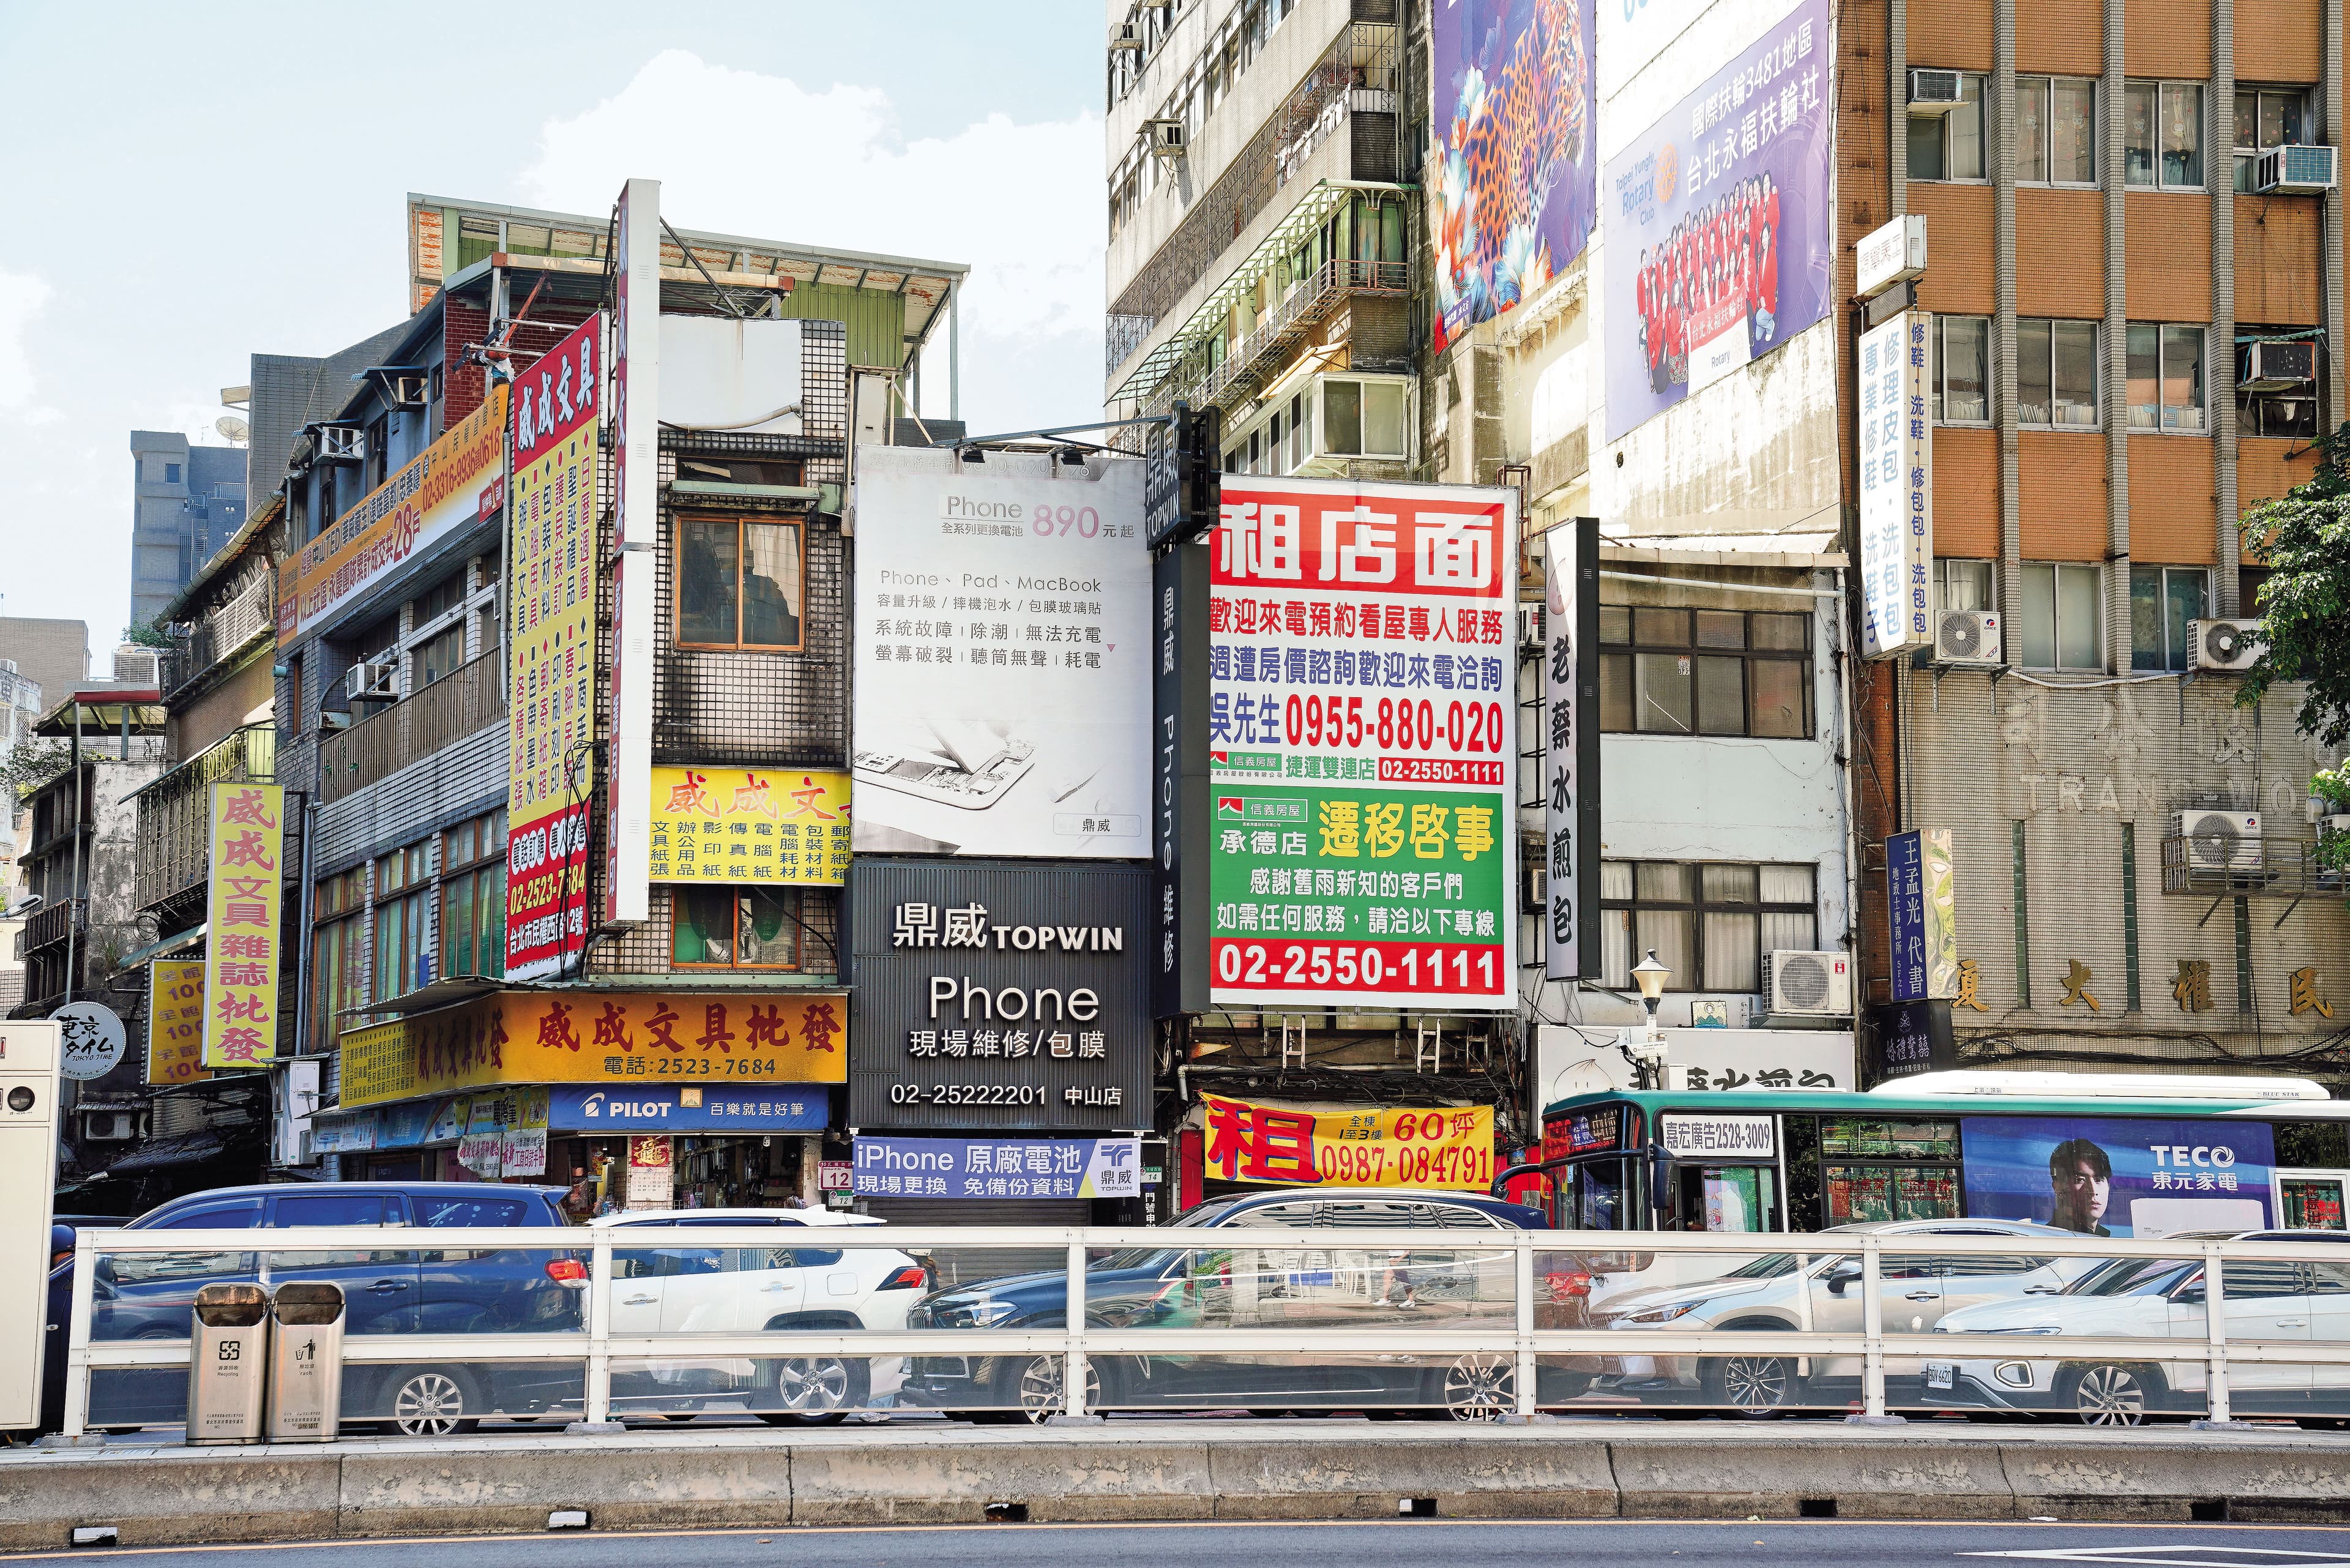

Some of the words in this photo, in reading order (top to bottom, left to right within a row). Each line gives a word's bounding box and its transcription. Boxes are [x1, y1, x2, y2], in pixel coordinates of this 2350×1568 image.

[1691, 18, 1813, 141] 國際扶輪3481地區
[1686, 64, 1820, 197] 台北永福扶輪社
[1616, 166, 1633, 192] Taipei
[1635, 151, 1654, 176] Yungfu
[1623, 176, 1654, 216] Rotary
[1640, 206, 1654, 225] Club
[1712, 350, 1730, 368] Rotary
[518, 336, 594, 450] 威成文具
[423, 447, 476, 512] 02-3316-9936
[480, 426, 500, 469] 0618
[1146, 412, 1179, 496] 鼎威
[578, 456, 591, 602] 日曆週曆
[942, 523, 1023, 537] 全系列更換電池
[947, 495, 1023, 519] Phone
[1033, 505, 1099, 539] 890
[1103, 524, 1135, 539] 元起
[1146, 491, 1180, 539] TOPWIN
[542, 484, 552, 622] 包裝材料
[553, 472, 564, 616] 護貝裝訂
[566, 466, 578, 608] 聖誕禮品
[1220, 502, 1493, 589] 租店面
[517, 501, 527, 638] 辦公文具
[529, 491, 539, 632] 電腦用具
[1018, 577, 1102, 592] MacBook
[877, 594, 936, 609] 容量升級
[953, 595, 1012, 611] 摔機泡水
[1029, 599, 1102, 614] 包膜玻璃貼
[1210, 597, 1502, 645] 歡迎來電預約看屋專人服務
[875, 619, 953, 638] 系統故障
[970, 622, 1009, 640] 除潮
[1026, 624, 1102, 643] 無法充電
[1163, 587, 1174, 676] 鼎威
[875, 644, 953, 663] 螢幕破裂
[971, 648, 1048, 666] 聽筒無聲
[1065, 651, 1102, 668] 耗電
[1210, 645, 1502, 692] 週遭房價諮詢歡迎來電洽詢
[515, 674, 525, 812] 各種紙張
[525, 666, 536, 804] 色帶墨水
[539, 660, 550, 801] 郵寄紙箱
[551, 653, 561, 794] 印刷刻印
[1210, 692, 1281, 744] 吳先生
[1286, 693, 1503, 754] 0955-880-020
[1234, 756, 1277, 767] 信義房屋
[1286, 756, 1375, 781] 捷運雙連店
[1382, 761, 1502, 783] 02-2550-1111
[1163, 714, 1174, 871] Phone
[1250, 803, 1300, 816] 信義房屋
[1552, 635, 1573, 945] 老蔡水煎包
[651, 821, 670, 876] 文具紙張
[677, 821, 696, 876] 辦公用品
[1082, 818, 1111, 832] 鼎威
[1219, 829, 1307, 856] 承德店
[513, 833, 545, 868] 電話訂購
[703, 822, 722, 877] 影印紙
[728, 823, 748, 878] 傳真紙
[753, 823, 772, 878] 電腦紙
[780, 824, 799, 879] 電腦耗材
[805, 824, 823, 879] 包裝材料
[830, 825, 849, 879] 郵寄紙箱
[1250, 867, 1462, 900] 感謝舊雨新知的客戶們
[1904, 837, 1921, 925] 王孟光
[217, 788, 275, 1064] 威成文具雜誌批發
[892, 902, 988, 948] 鼎威
[991, 926, 1122, 951] TOPWIN
[1163, 885, 1174, 973] 維修
[1892, 867, 1902, 955] 地政士事務所
[1218, 944, 1493, 988] 02-2550-1111
[1908, 936, 1923, 995] 代書
[930, 976, 1100, 1021] Phone
[57, 1015, 99, 1042] 東京
[65, 1037, 114, 1058] タイム
[536, 1001, 841, 1053] 威成文具批發
[909, 1029, 1105, 1058] 現場維修/包膜
[610, 1103, 671, 1117] PILOT
[711, 1102, 804, 1116] 百樂就是好筆
[890, 1084, 1046, 1105] 02-25222201
[1064, 1086, 1122, 1105] 中山店
[1207, 1100, 1323, 1182] 租
[1339, 1129, 1382, 1141] 1至3樓
[1350, 1116, 1375, 1127] 全棟
[1666, 1122, 1770, 1150] 嘉宏廣告2528-3009
[830, 1173, 849, 1186] 12
[857, 1145, 954, 1170] iPhone
[964, 1145, 1082, 1174] 原廠電池
[1101, 1170, 1132, 1185] 鼎威
[1322, 1144, 1489, 1184] 0987-084791
[2150, 1146, 2234, 1168] TECO
[2152, 1171, 2238, 1191] 東元家電
[857, 1176, 947, 1194] 現場更換
[963, 1177, 1075, 1196] 免備份資料
